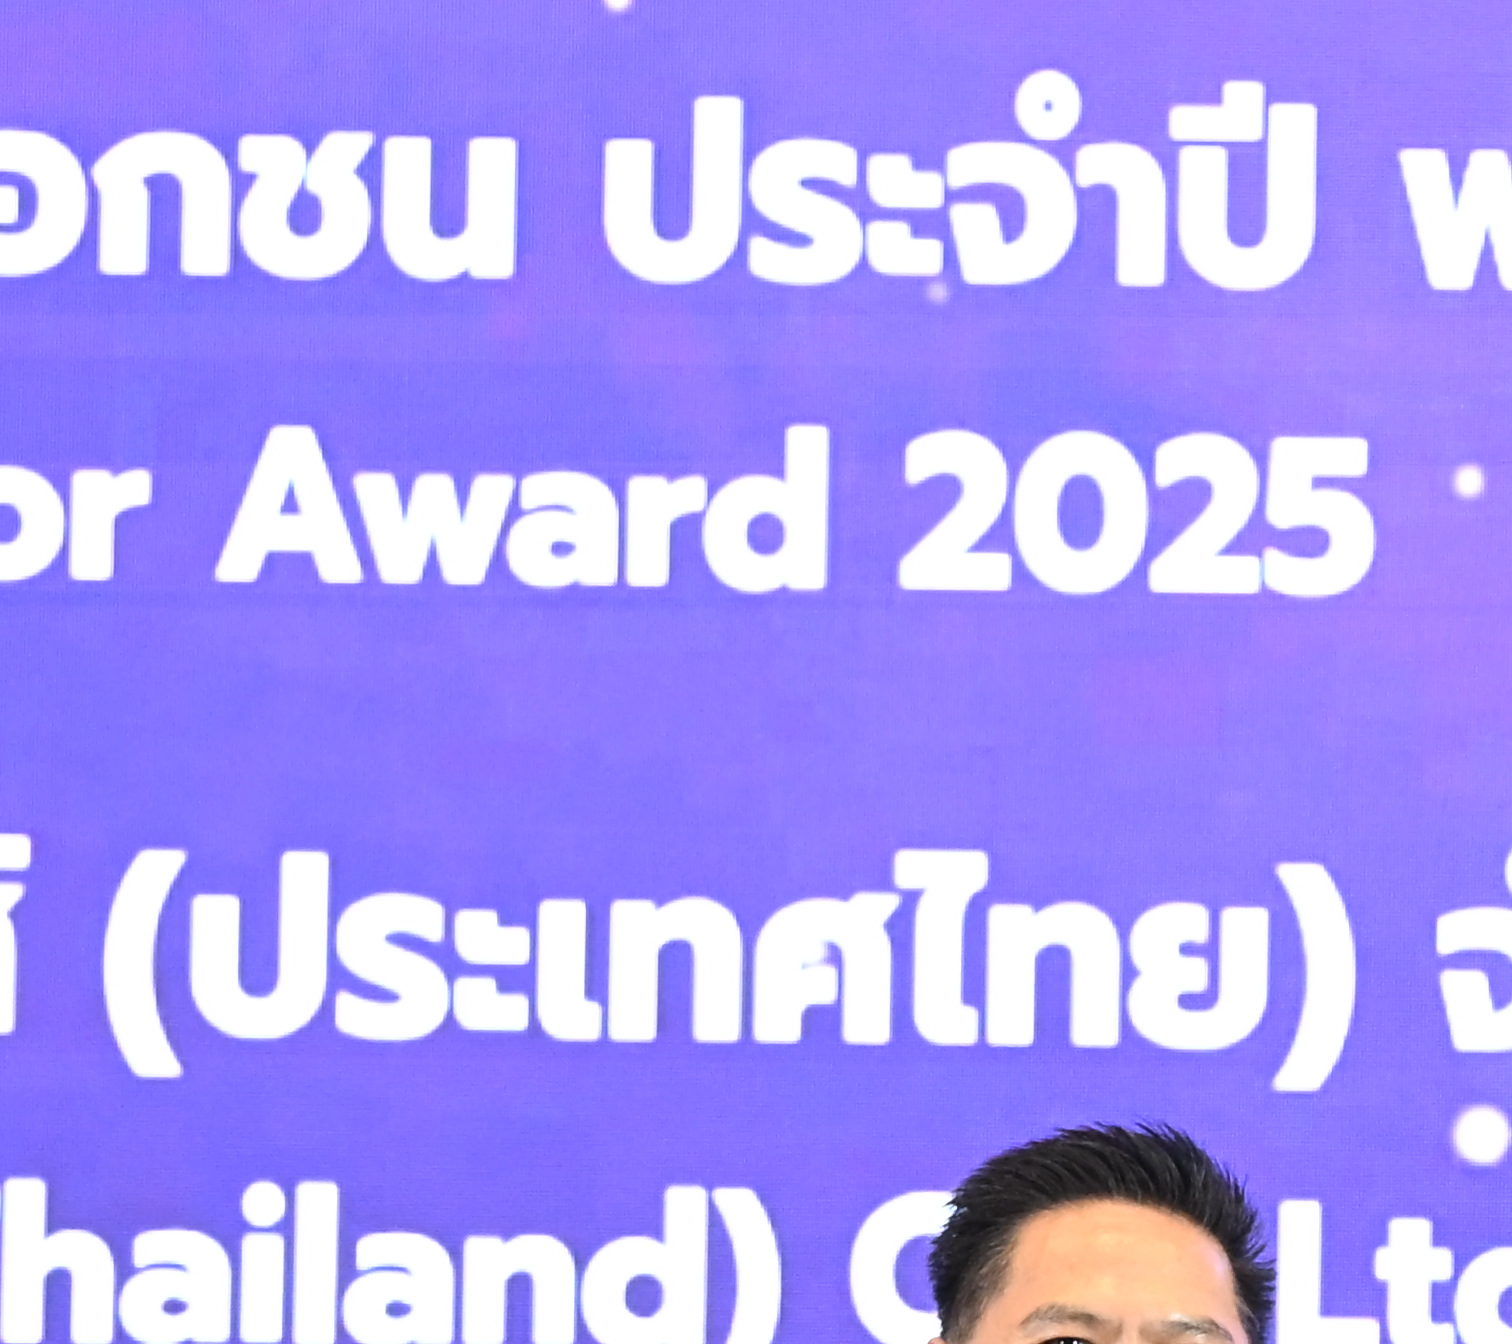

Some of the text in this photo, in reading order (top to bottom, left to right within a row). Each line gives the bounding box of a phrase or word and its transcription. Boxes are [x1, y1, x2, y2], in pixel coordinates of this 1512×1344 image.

[602, 70, 1319, 291] ประจำปี
[214, 425, 830, 586] Award
[898, 430, 1375, 597] 2025
[102, 849, 1356, 1092] (ประเทศไทย)
